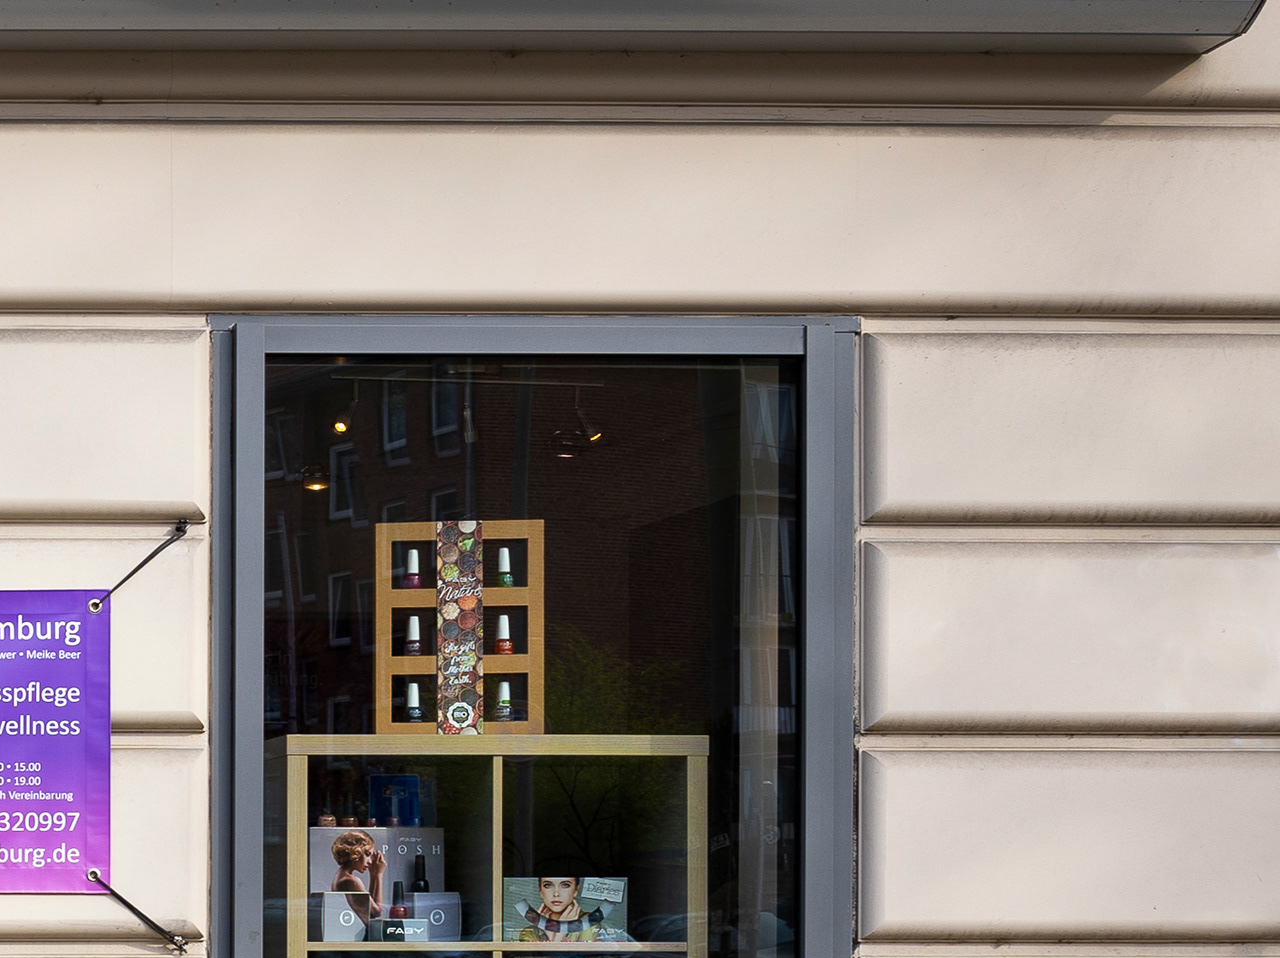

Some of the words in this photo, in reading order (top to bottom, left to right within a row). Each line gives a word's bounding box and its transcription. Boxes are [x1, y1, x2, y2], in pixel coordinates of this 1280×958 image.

[26, 649, 57, 660] Meike
[58, 649, 81, 660] Beer
[14, 762, 41, 772] 15.00
[14, 776, 41, 786] 19.00
[8, 790, 74, 802] Vereinbarung
[382, 844, 441, 855] POSH
[386, 927, 424, 935] FABY
